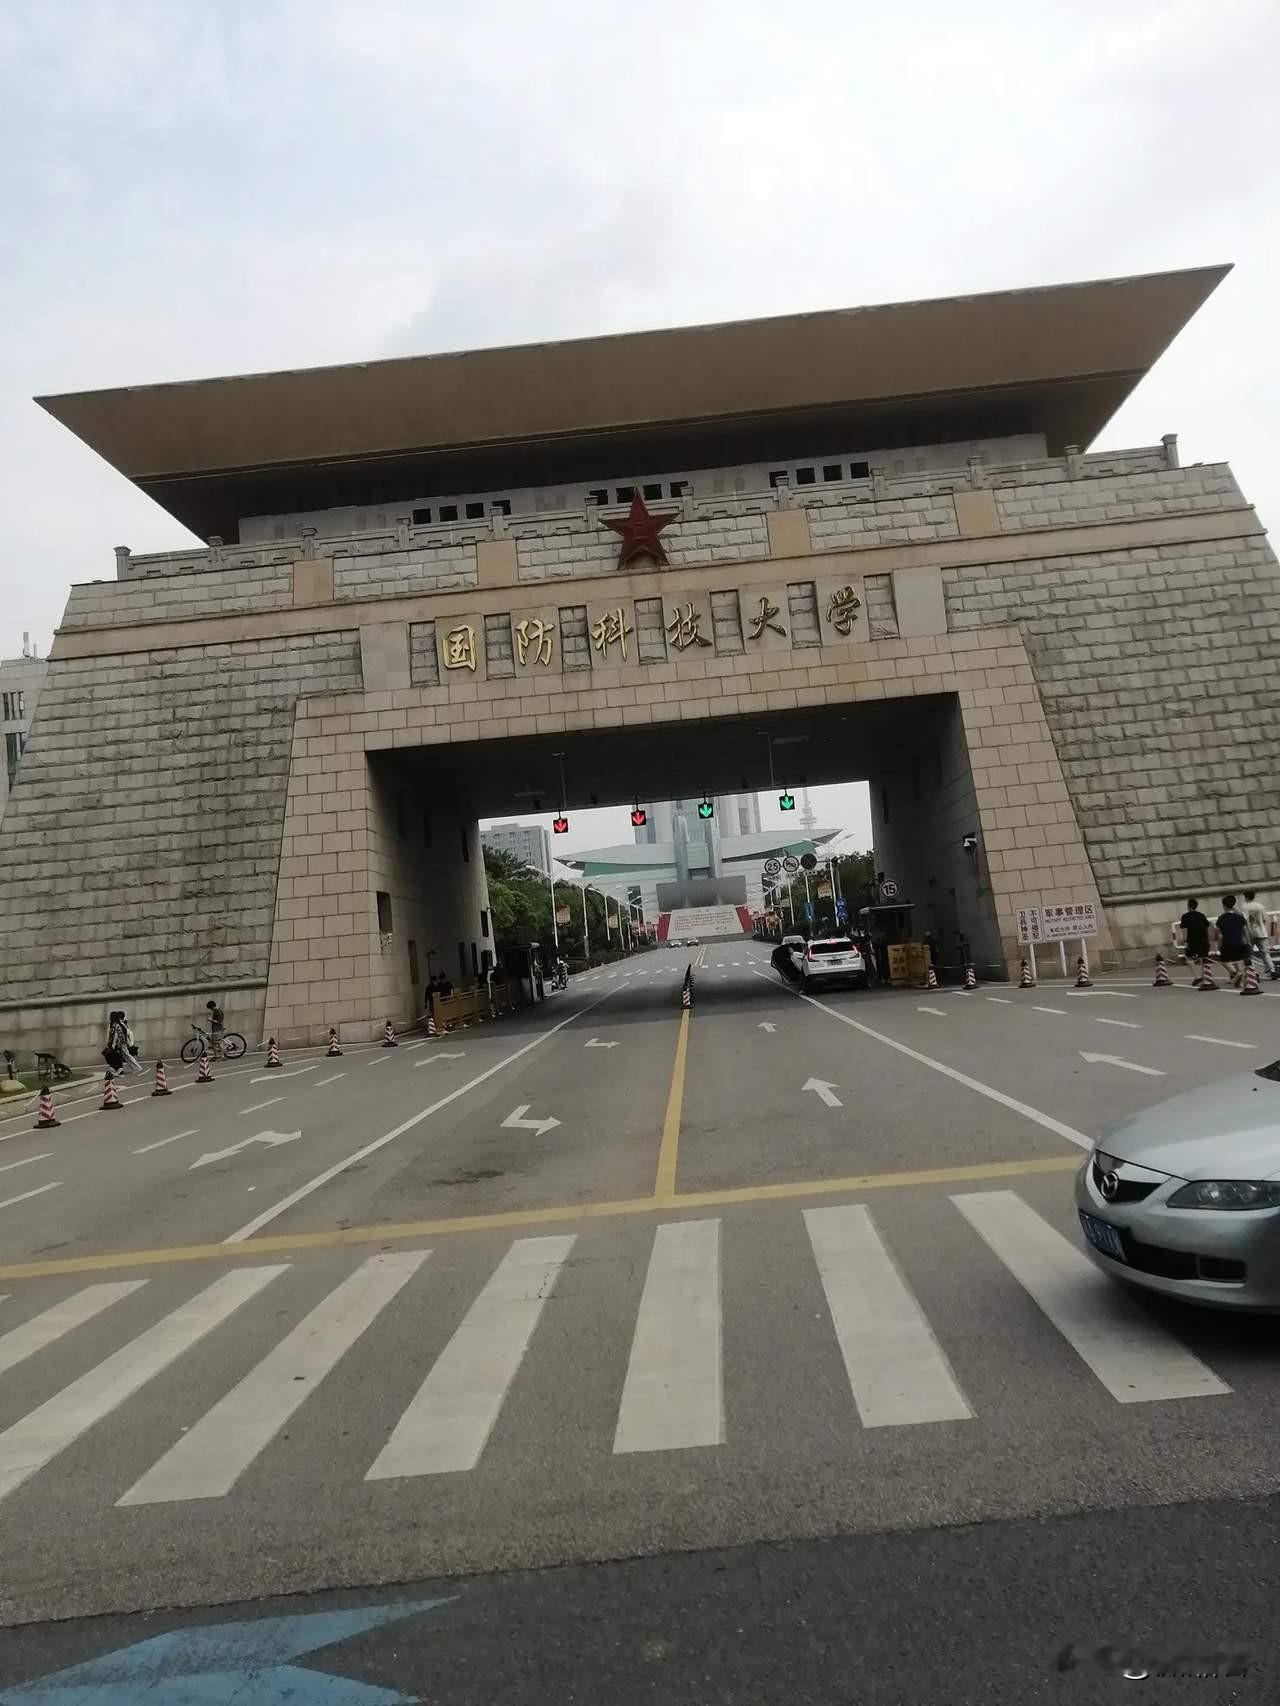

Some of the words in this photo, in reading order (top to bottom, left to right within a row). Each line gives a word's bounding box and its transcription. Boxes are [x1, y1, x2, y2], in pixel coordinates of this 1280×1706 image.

[441, 584, 864, 673] 国防科技大学
[883, 883, 896, 895] 15
